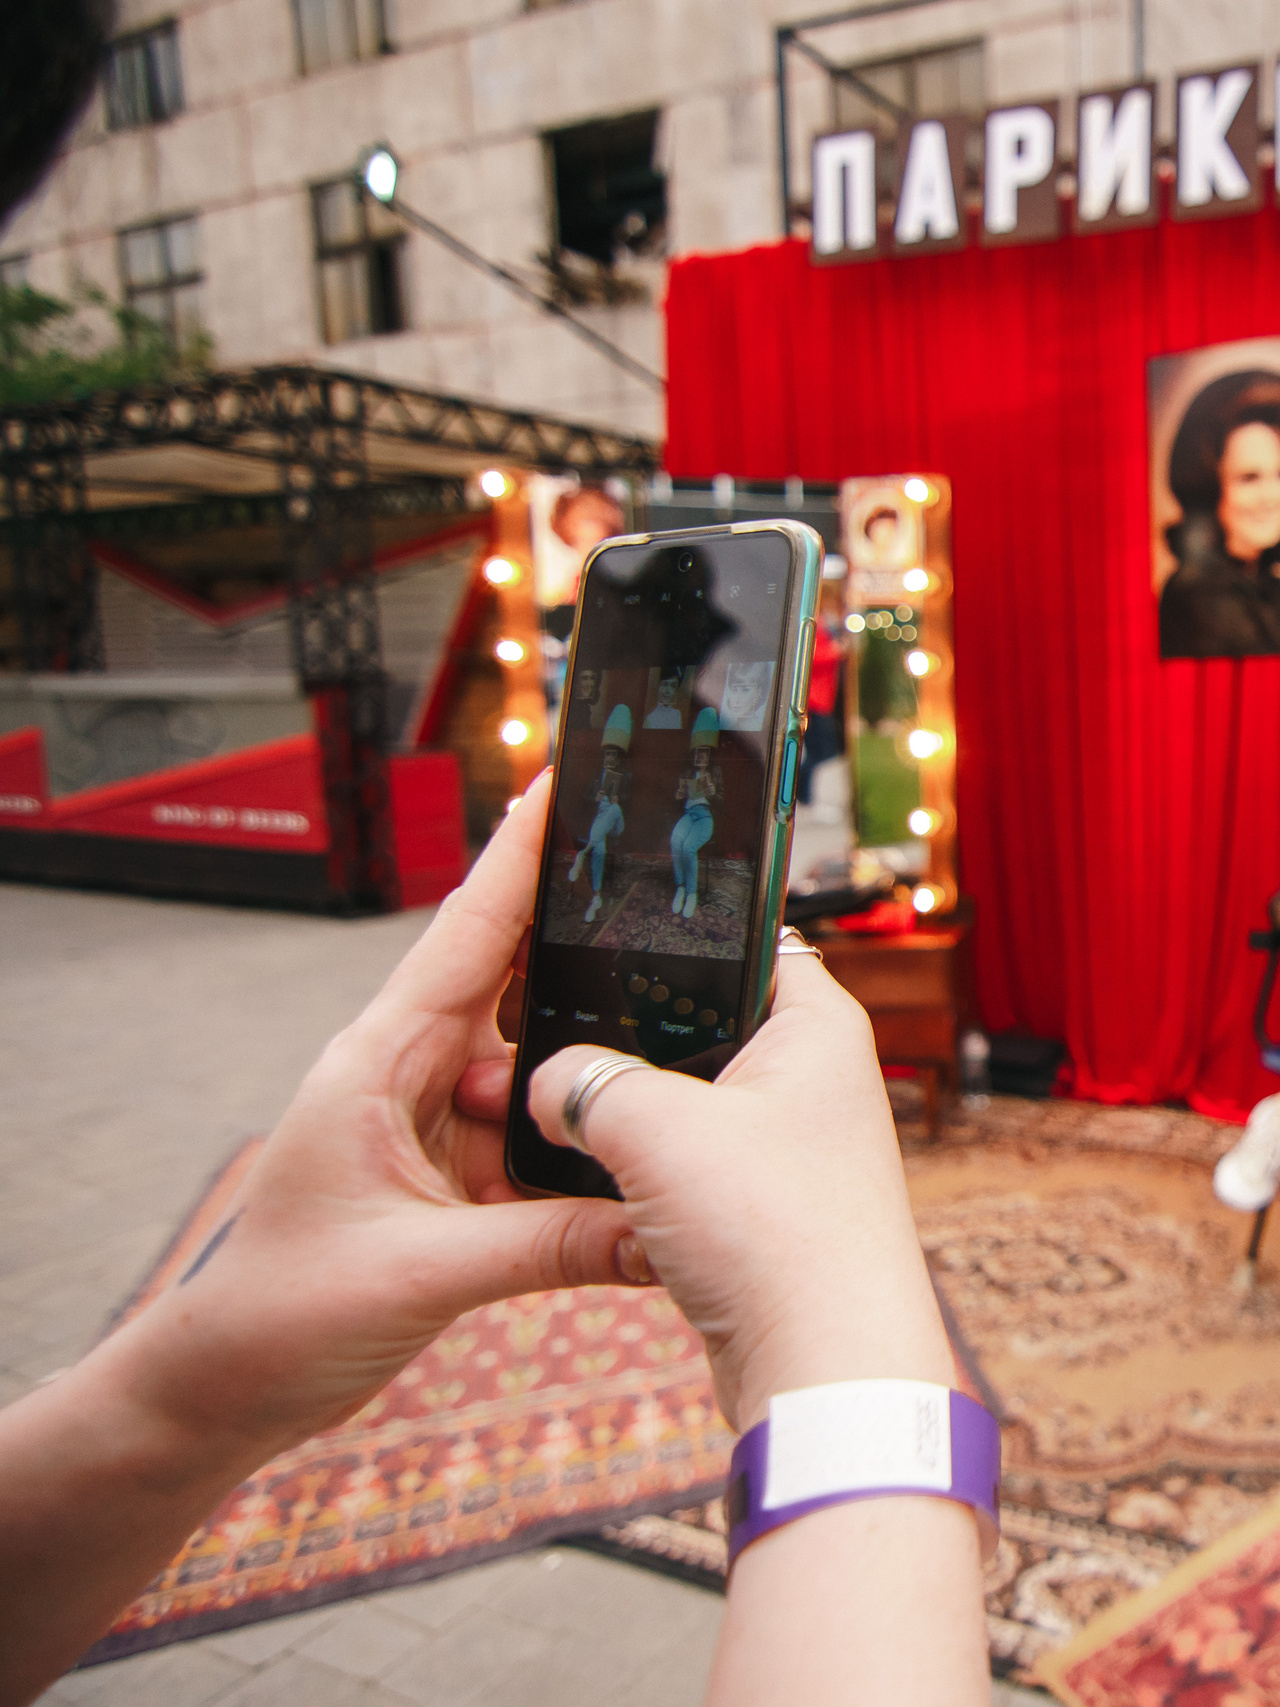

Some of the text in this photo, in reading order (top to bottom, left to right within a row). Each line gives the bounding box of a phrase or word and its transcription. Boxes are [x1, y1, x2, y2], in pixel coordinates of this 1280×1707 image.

[575, 1010, 599, 1022] Видео
[619, 1016, 640, 1027] Фото
[661, 1021, 695, 1035] Портрет
